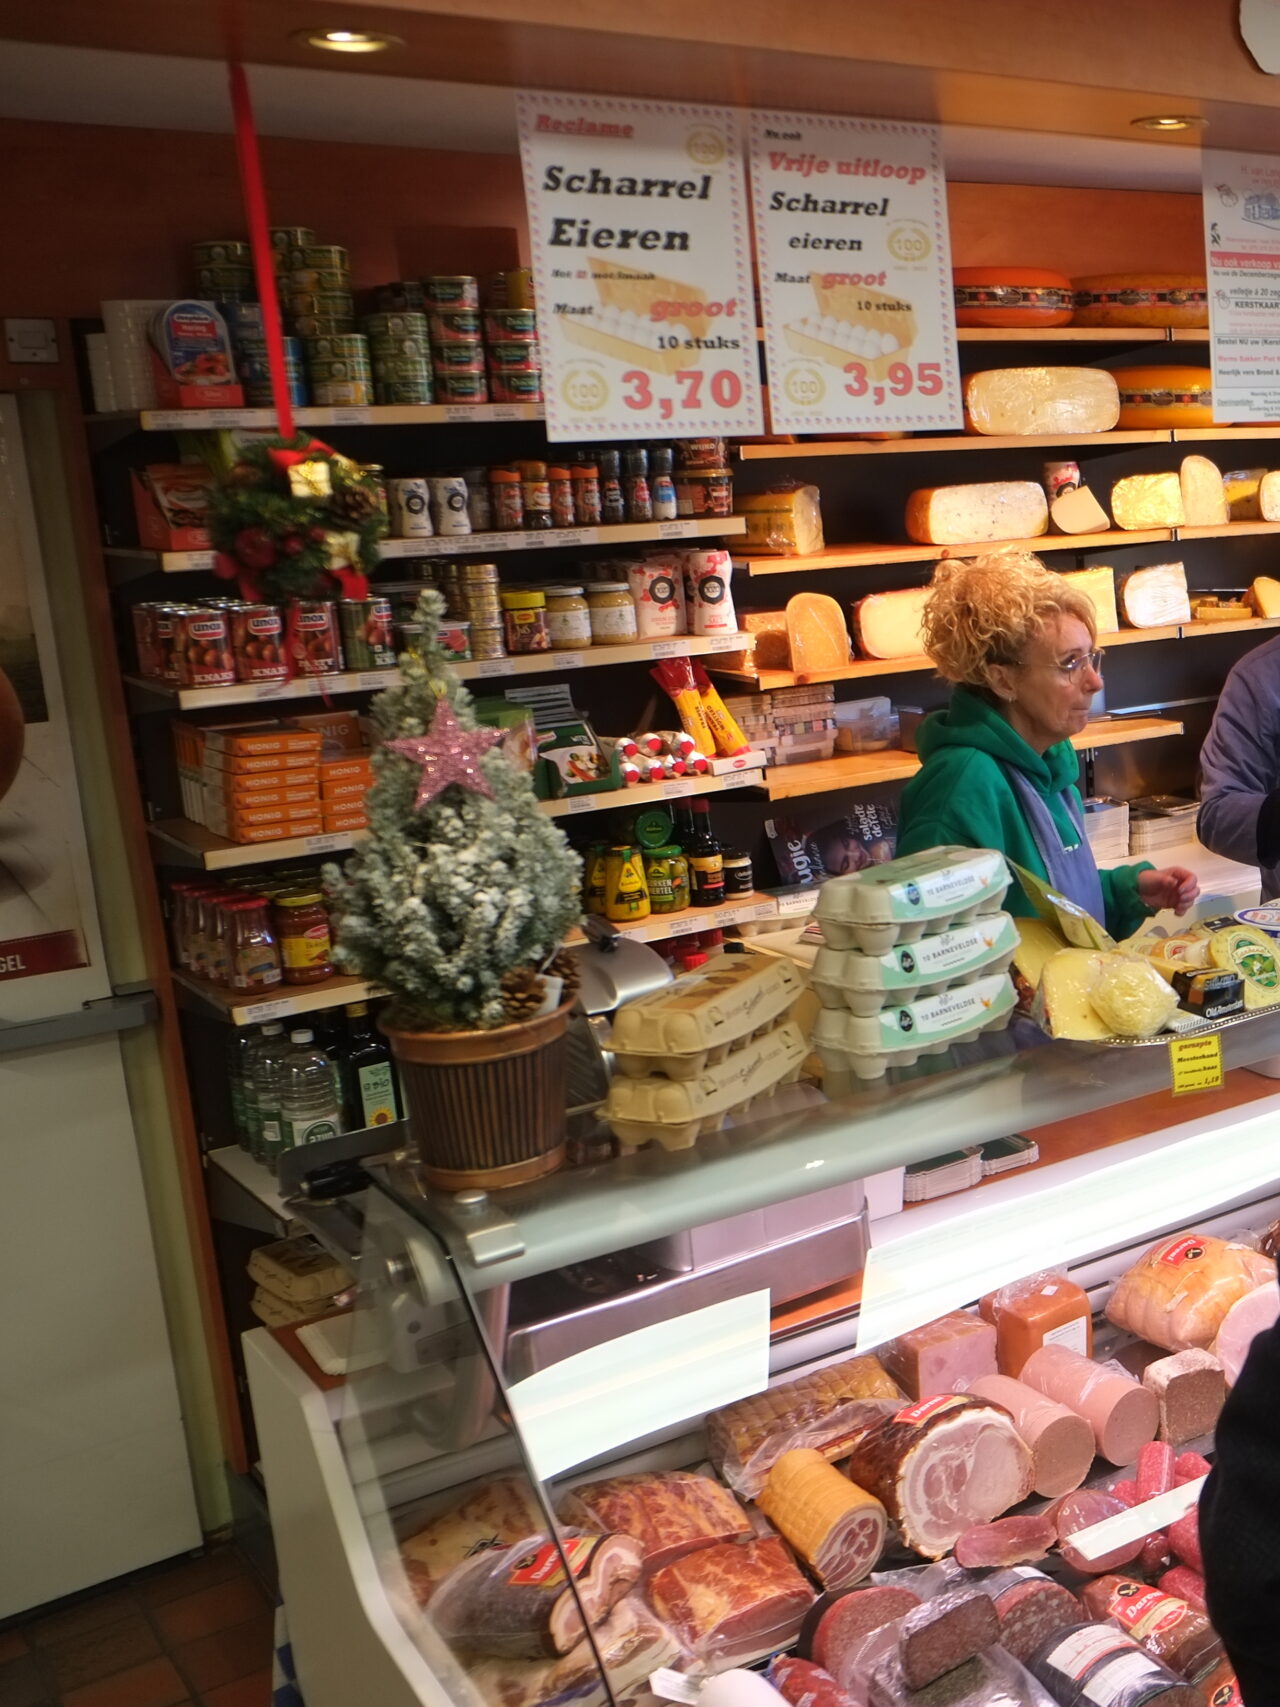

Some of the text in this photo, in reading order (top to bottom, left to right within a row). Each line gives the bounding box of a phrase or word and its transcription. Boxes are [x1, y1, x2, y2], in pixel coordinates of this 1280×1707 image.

[535, 114, 634, 138] Reclame
[769, 152, 926, 185] Vrije uitloop
[542, 164, 712, 200] Scharrel
[769, 191, 889, 217] Scharrel
[549, 217, 691, 252] Eieren
[789, 234, 863, 252] eieren
[774, 270, 886, 290] Maat groot
[1260, 288, 1268, 296] 20
[553, 303, 594, 315] Maat
[650, 298, 737, 322] groot
[856, 300, 912, 312] 10 stuks
[657, 335, 740, 350] 10 stuks
[622, 369, 742, 419] 3,70
[843, 362, 943, 404] 3,95
